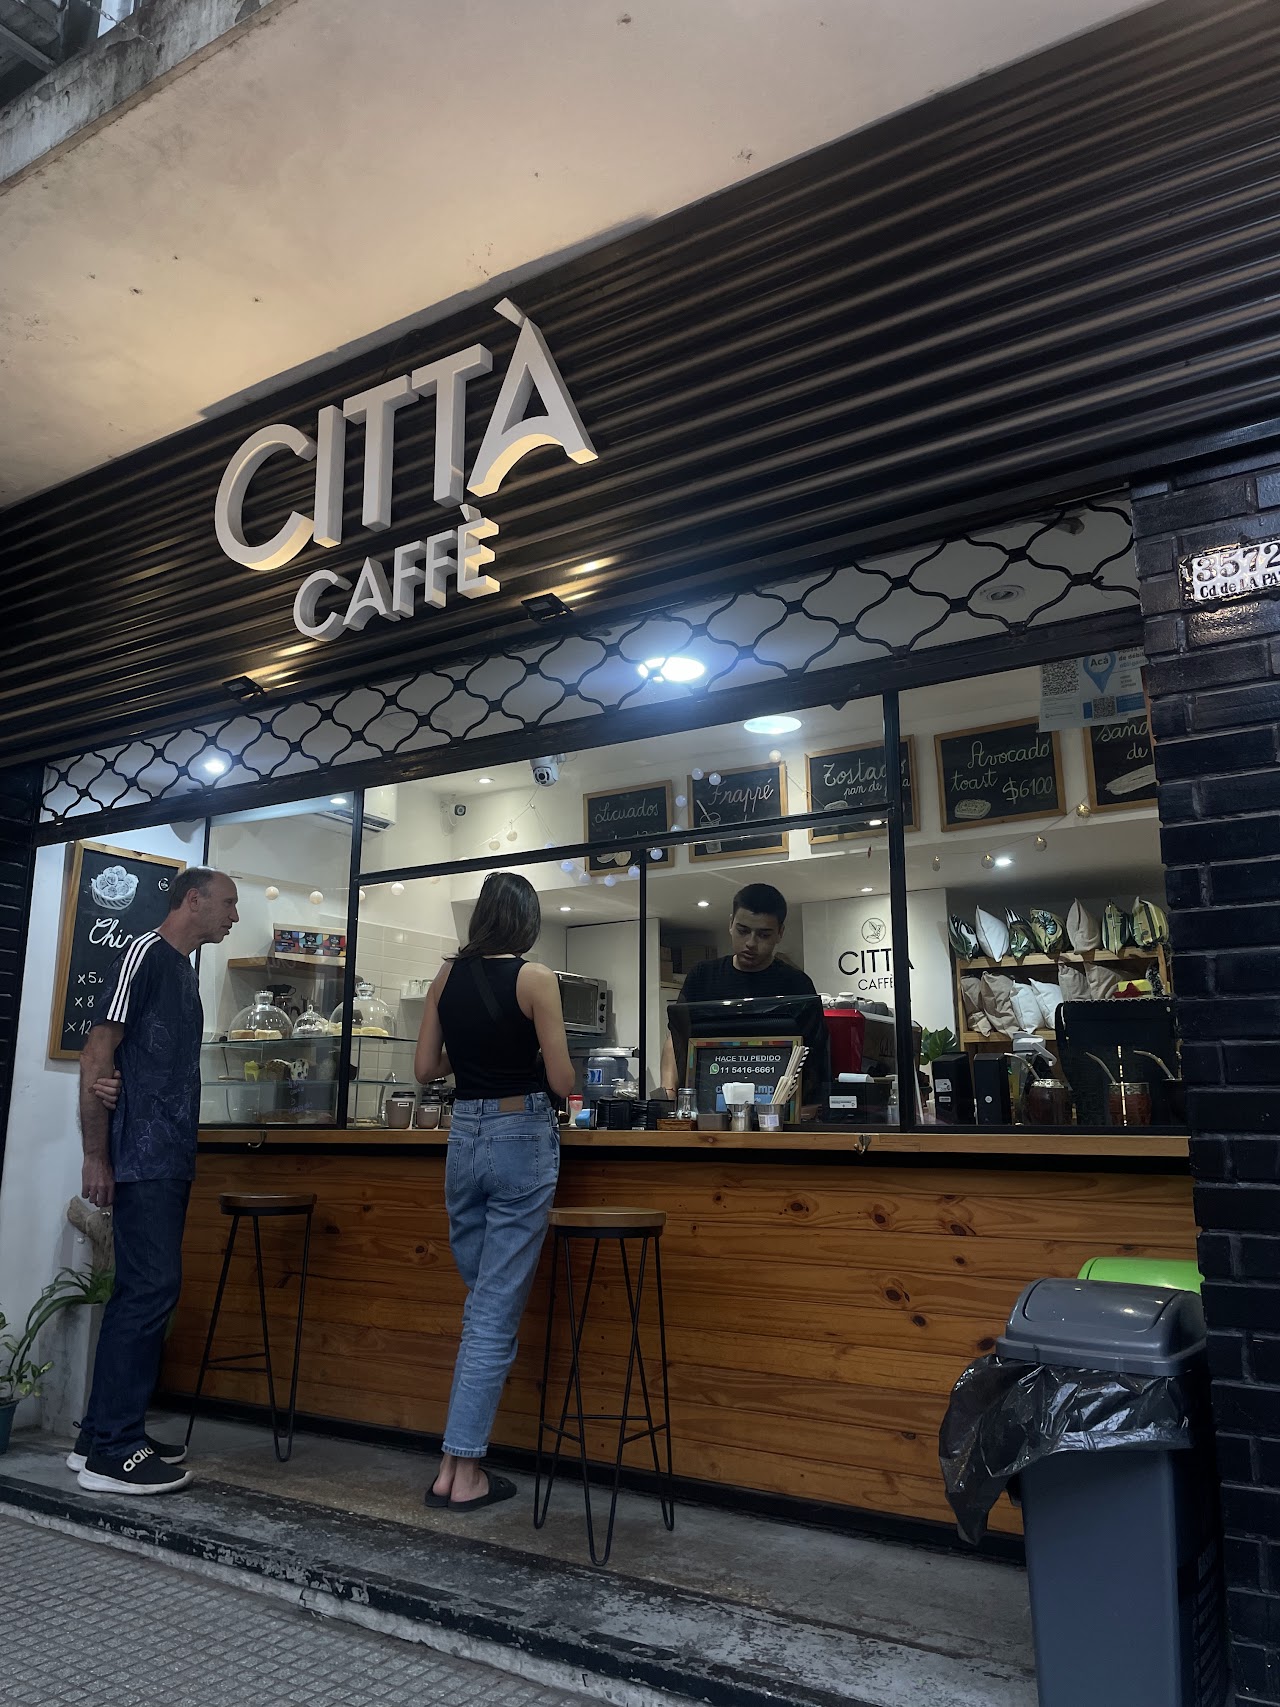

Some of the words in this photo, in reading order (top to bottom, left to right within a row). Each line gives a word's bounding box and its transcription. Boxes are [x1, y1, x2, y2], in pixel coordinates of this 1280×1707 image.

[215, 297, 599, 571] CITTÀ
[293, 504, 500, 642] CAFFÈ
[1196, 542, 1280, 582] 3572
[1220, 582, 1237, 594] de
[1127, 742, 1148, 760] de
[707, 778, 774, 813] Frappé
[843, 785, 866, 799] pan
[868, 781, 882, 792] de
[951, 768, 998, 792] toast
[1002, 776, 1053, 805] $6100
[595, 798, 659, 823] Licuados
[838, 948, 914, 975] CITT
